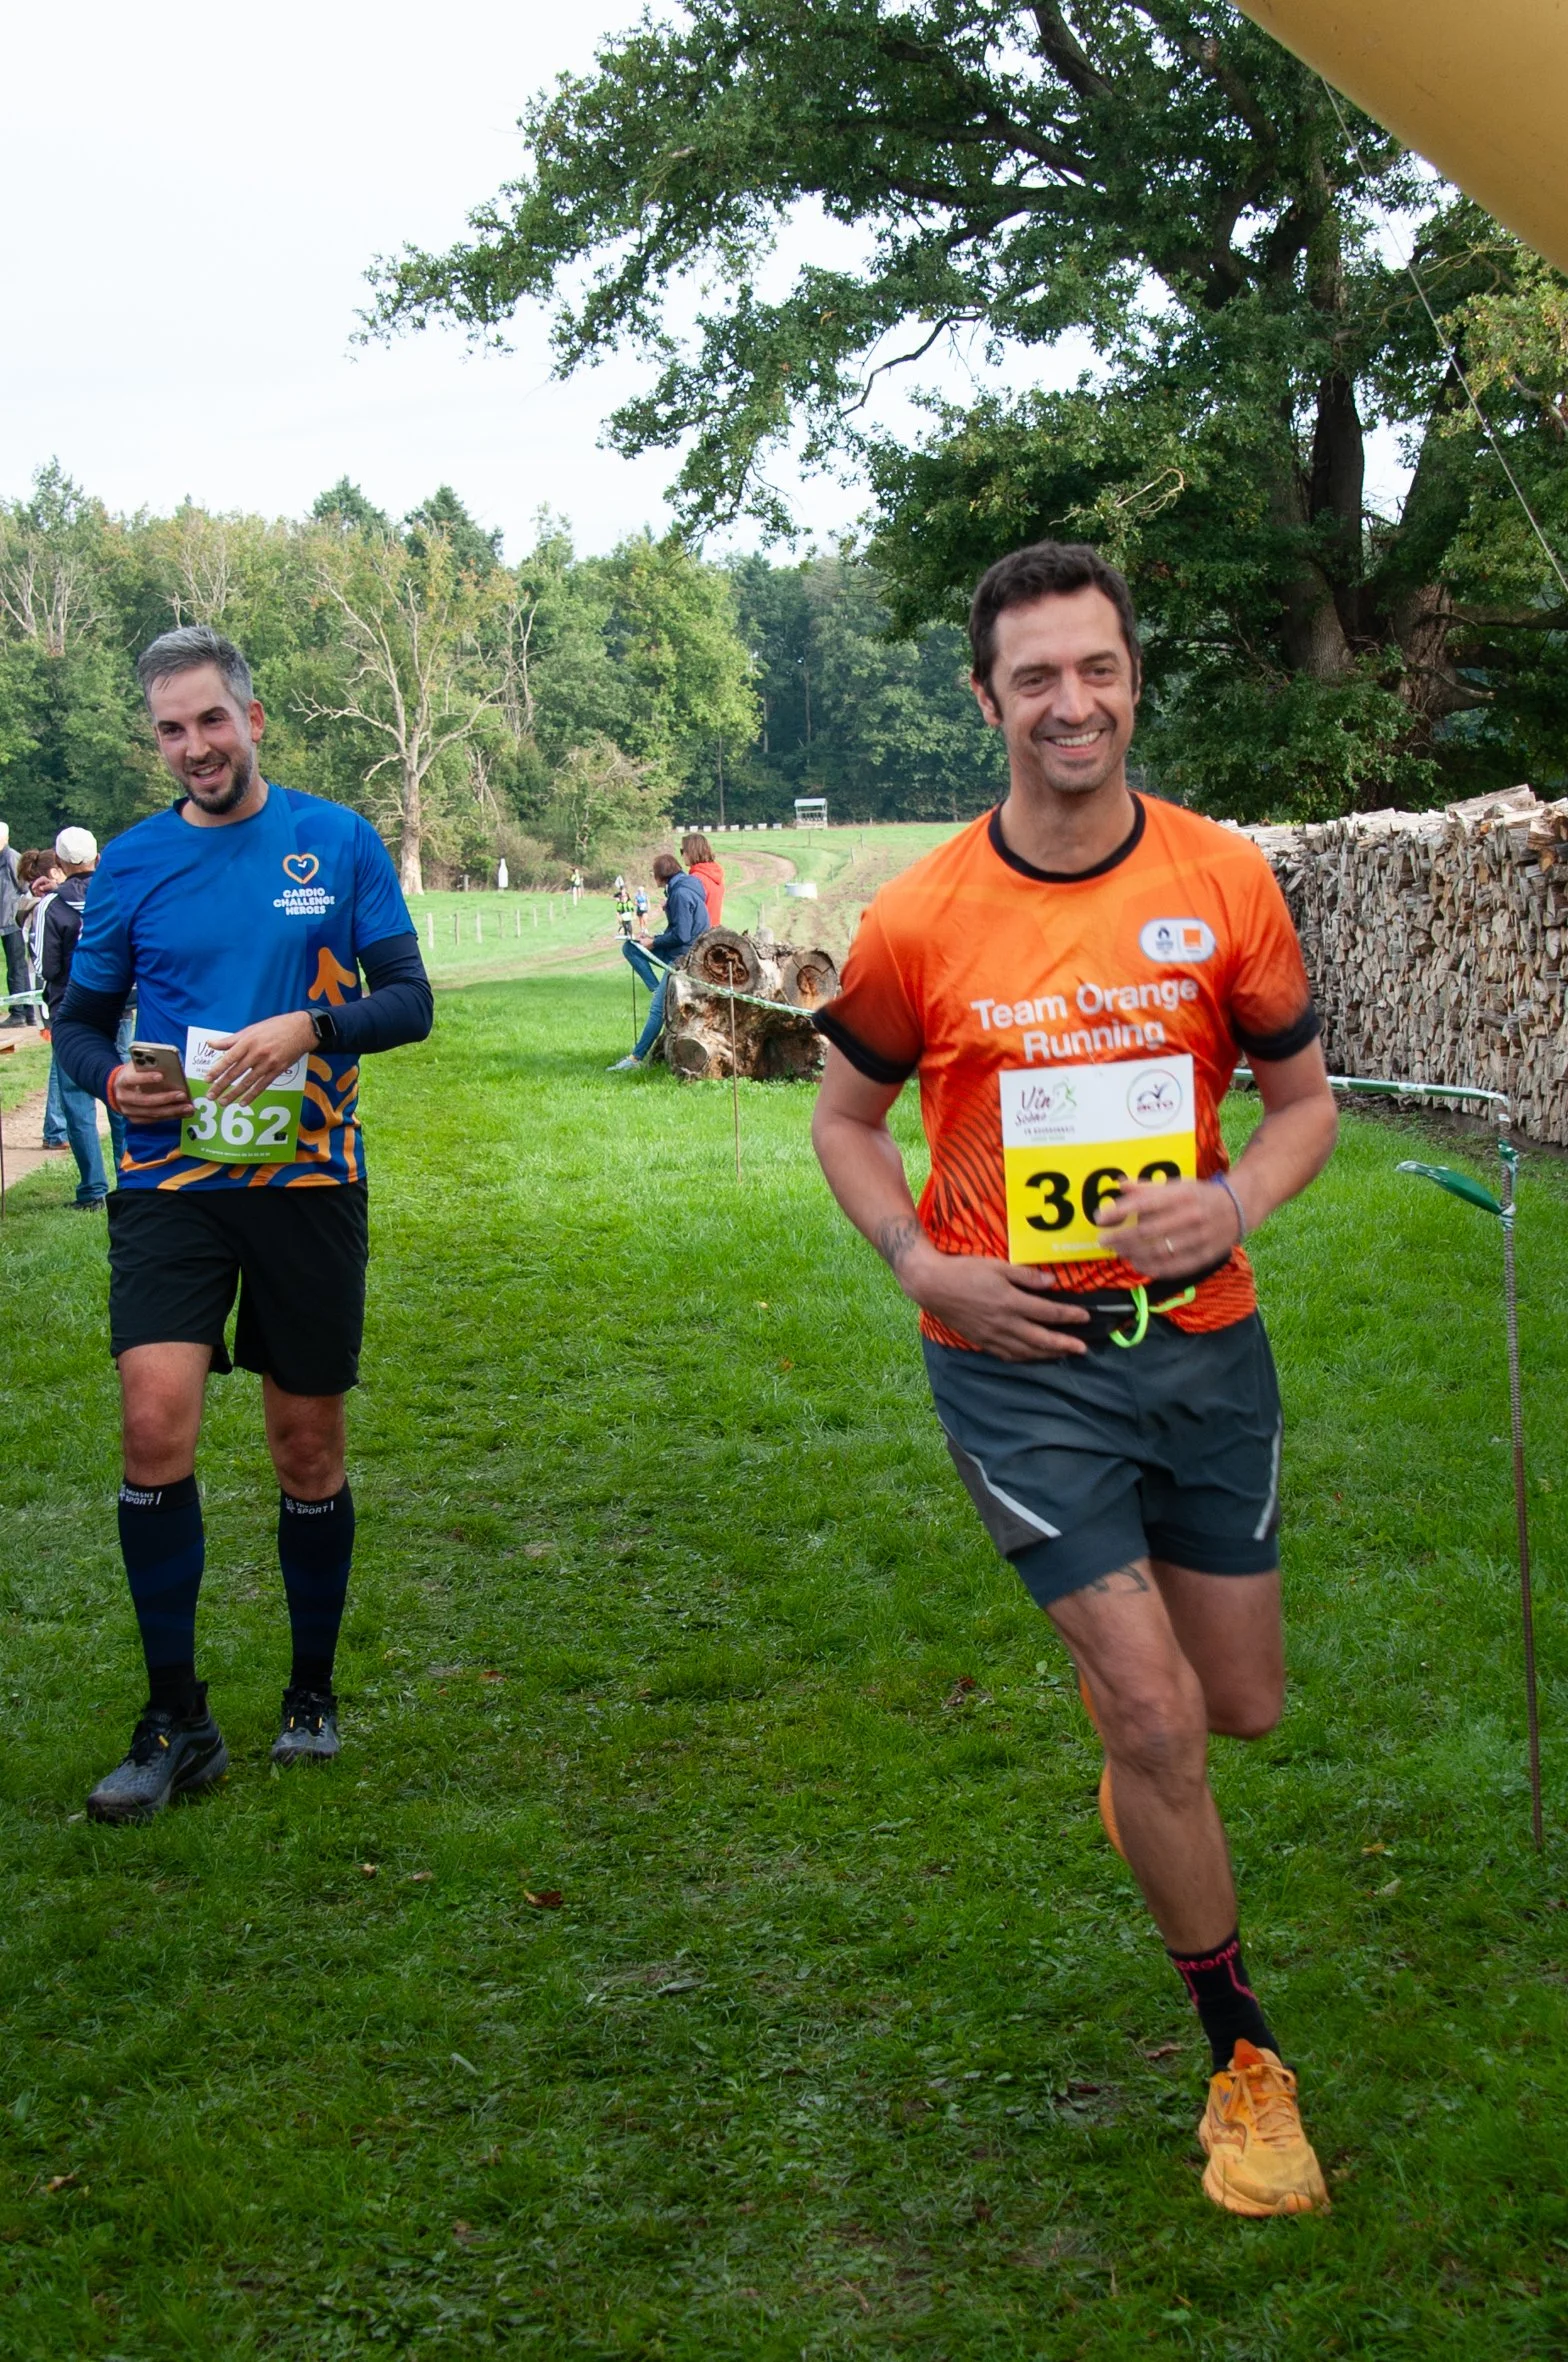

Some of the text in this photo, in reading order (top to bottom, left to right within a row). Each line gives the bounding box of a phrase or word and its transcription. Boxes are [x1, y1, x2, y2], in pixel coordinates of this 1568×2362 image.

[282, 887, 326, 898] CARDIO
[273, 895, 335, 908] CHALLENGE
[285, 905, 327, 916] HEROES
[970, 978, 1199, 1031] Team Orange
[1022, 1019, 1166, 1063] Running
[1021, 1085, 1051, 1110] Vin
[189, 1097, 291, 1146] 362
[125, 1495, 154, 1506] SPORT
[297, 1505, 328, 1515] SPORT
